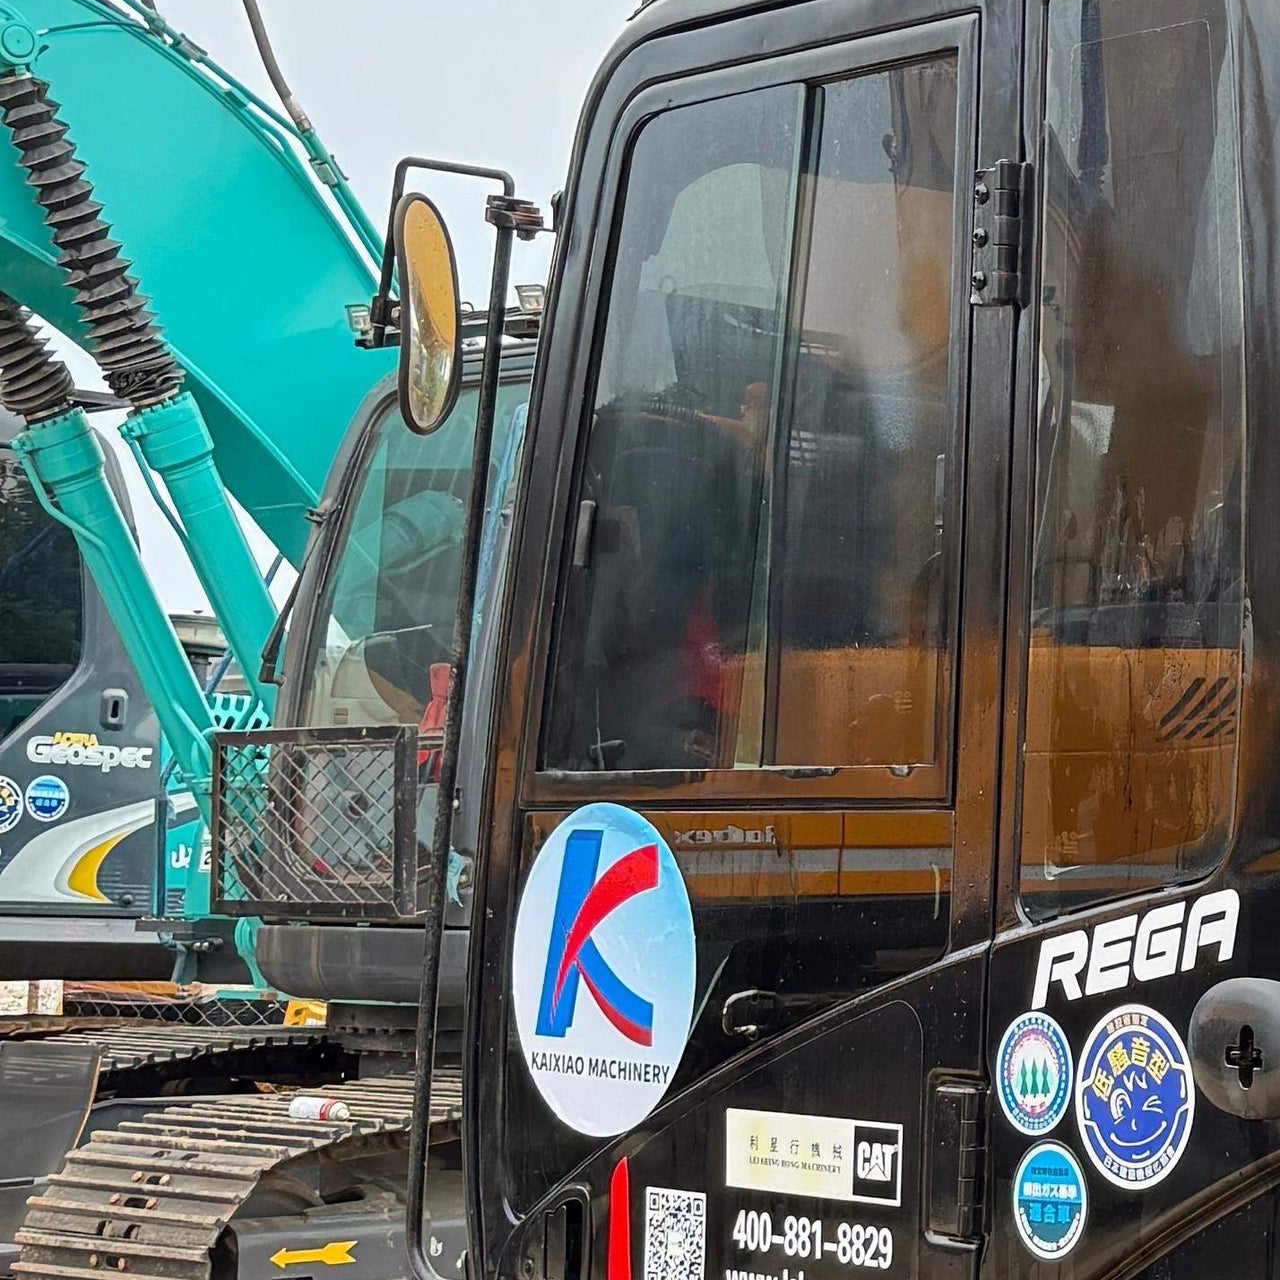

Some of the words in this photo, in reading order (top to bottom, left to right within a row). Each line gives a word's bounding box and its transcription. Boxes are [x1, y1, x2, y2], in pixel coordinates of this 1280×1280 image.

[1030, 888, 1241, 1010] REGA
[531, 1052, 585, 1076] KAIXIAO
[588, 1058, 670, 1085] MACHINERY
[857, 1141, 893, 1181] CAT
[732, 1209, 894, 1269] 400-881-8829
